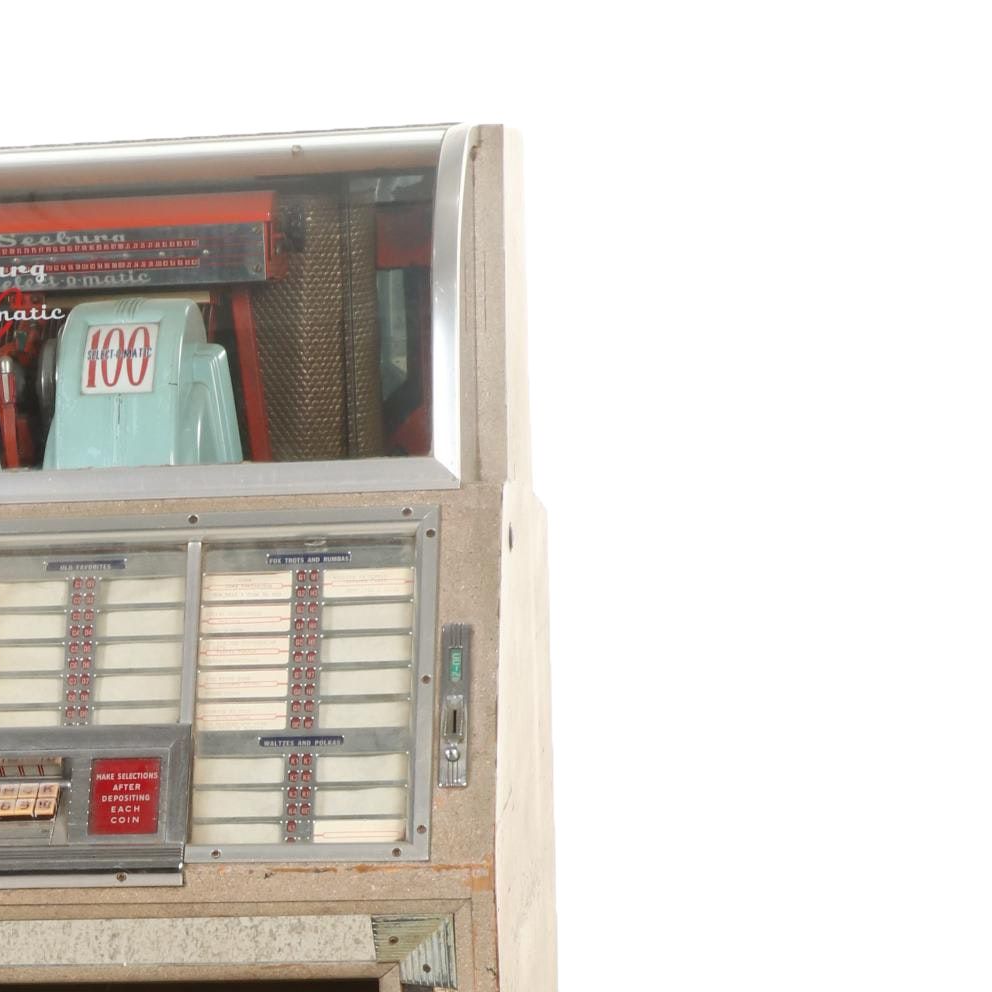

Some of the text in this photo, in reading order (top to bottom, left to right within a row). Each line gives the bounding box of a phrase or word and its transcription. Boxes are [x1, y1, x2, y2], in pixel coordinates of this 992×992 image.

[86, 326, 151, 388] 100
[95, 772, 159, 781] MAKE SELECTIONS
[112, 783, 141, 791] AFTER
[101, 793, 150, 802] DEPOSITING
[110, 805, 141, 813] EACH
[110, 816, 140, 824] COIN
